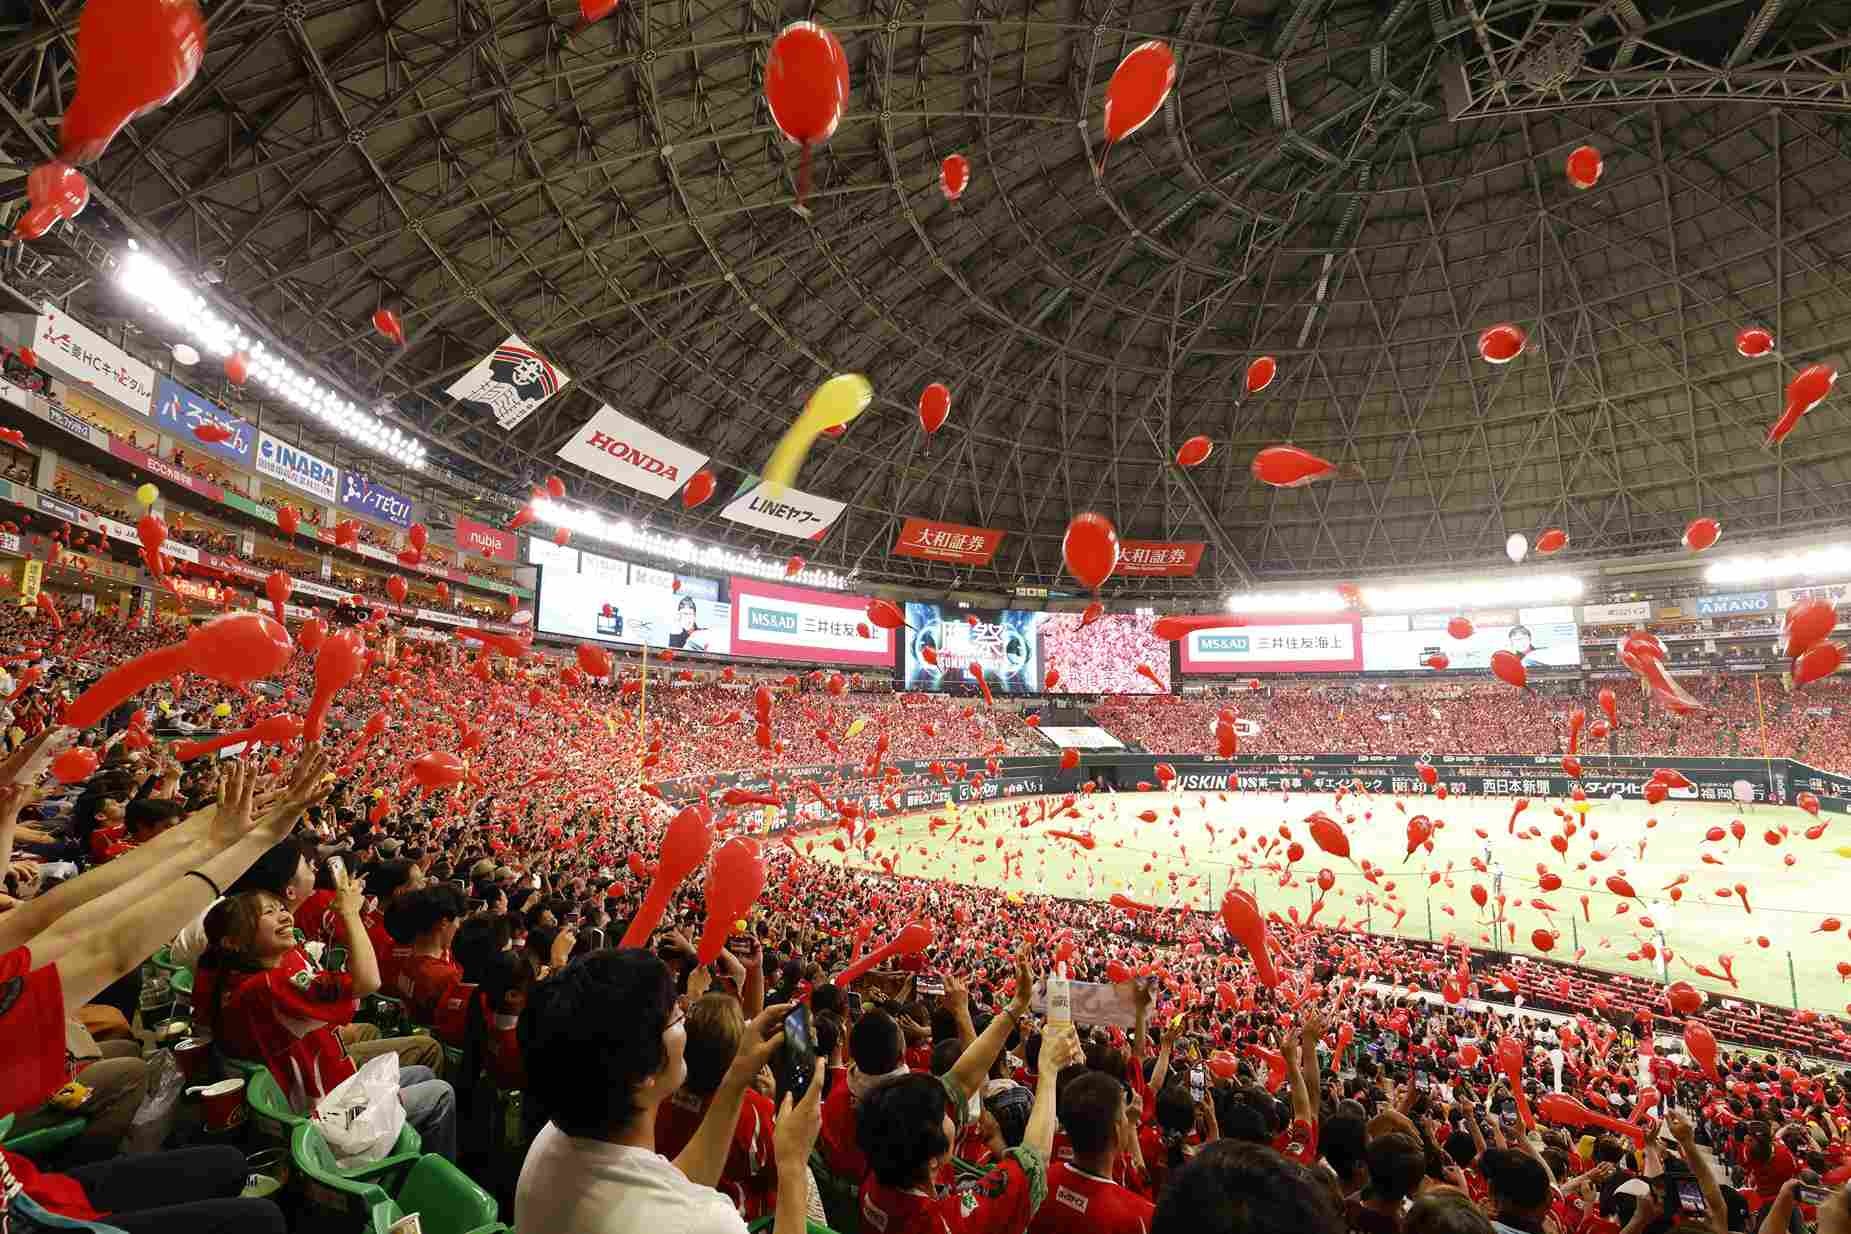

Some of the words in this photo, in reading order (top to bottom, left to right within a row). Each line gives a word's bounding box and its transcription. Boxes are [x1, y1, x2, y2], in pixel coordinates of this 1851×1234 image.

[585, 430, 680, 482] HONDA
[276, 446, 335, 486] INABA
[361, 488, 411, 519] Y-TECH
[748, 495, 822, 525] LINEヤフー
[470, 531, 502, 550] nubia
[917, 527, 985, 551] 大和証券
[1119, 547, 1186, 564] 大和証券
[1700, 597, 1769, 613] AMANO
[752, 608, 798, 631] MS&AD
[1200, 637, 1248, 649] MS&AD
[1256, 636, 1343, 650] 三井住友海上
[1175, 774, 1229, 790] USKIN
[1482, 778, 1550, 794] 西日本新聞
